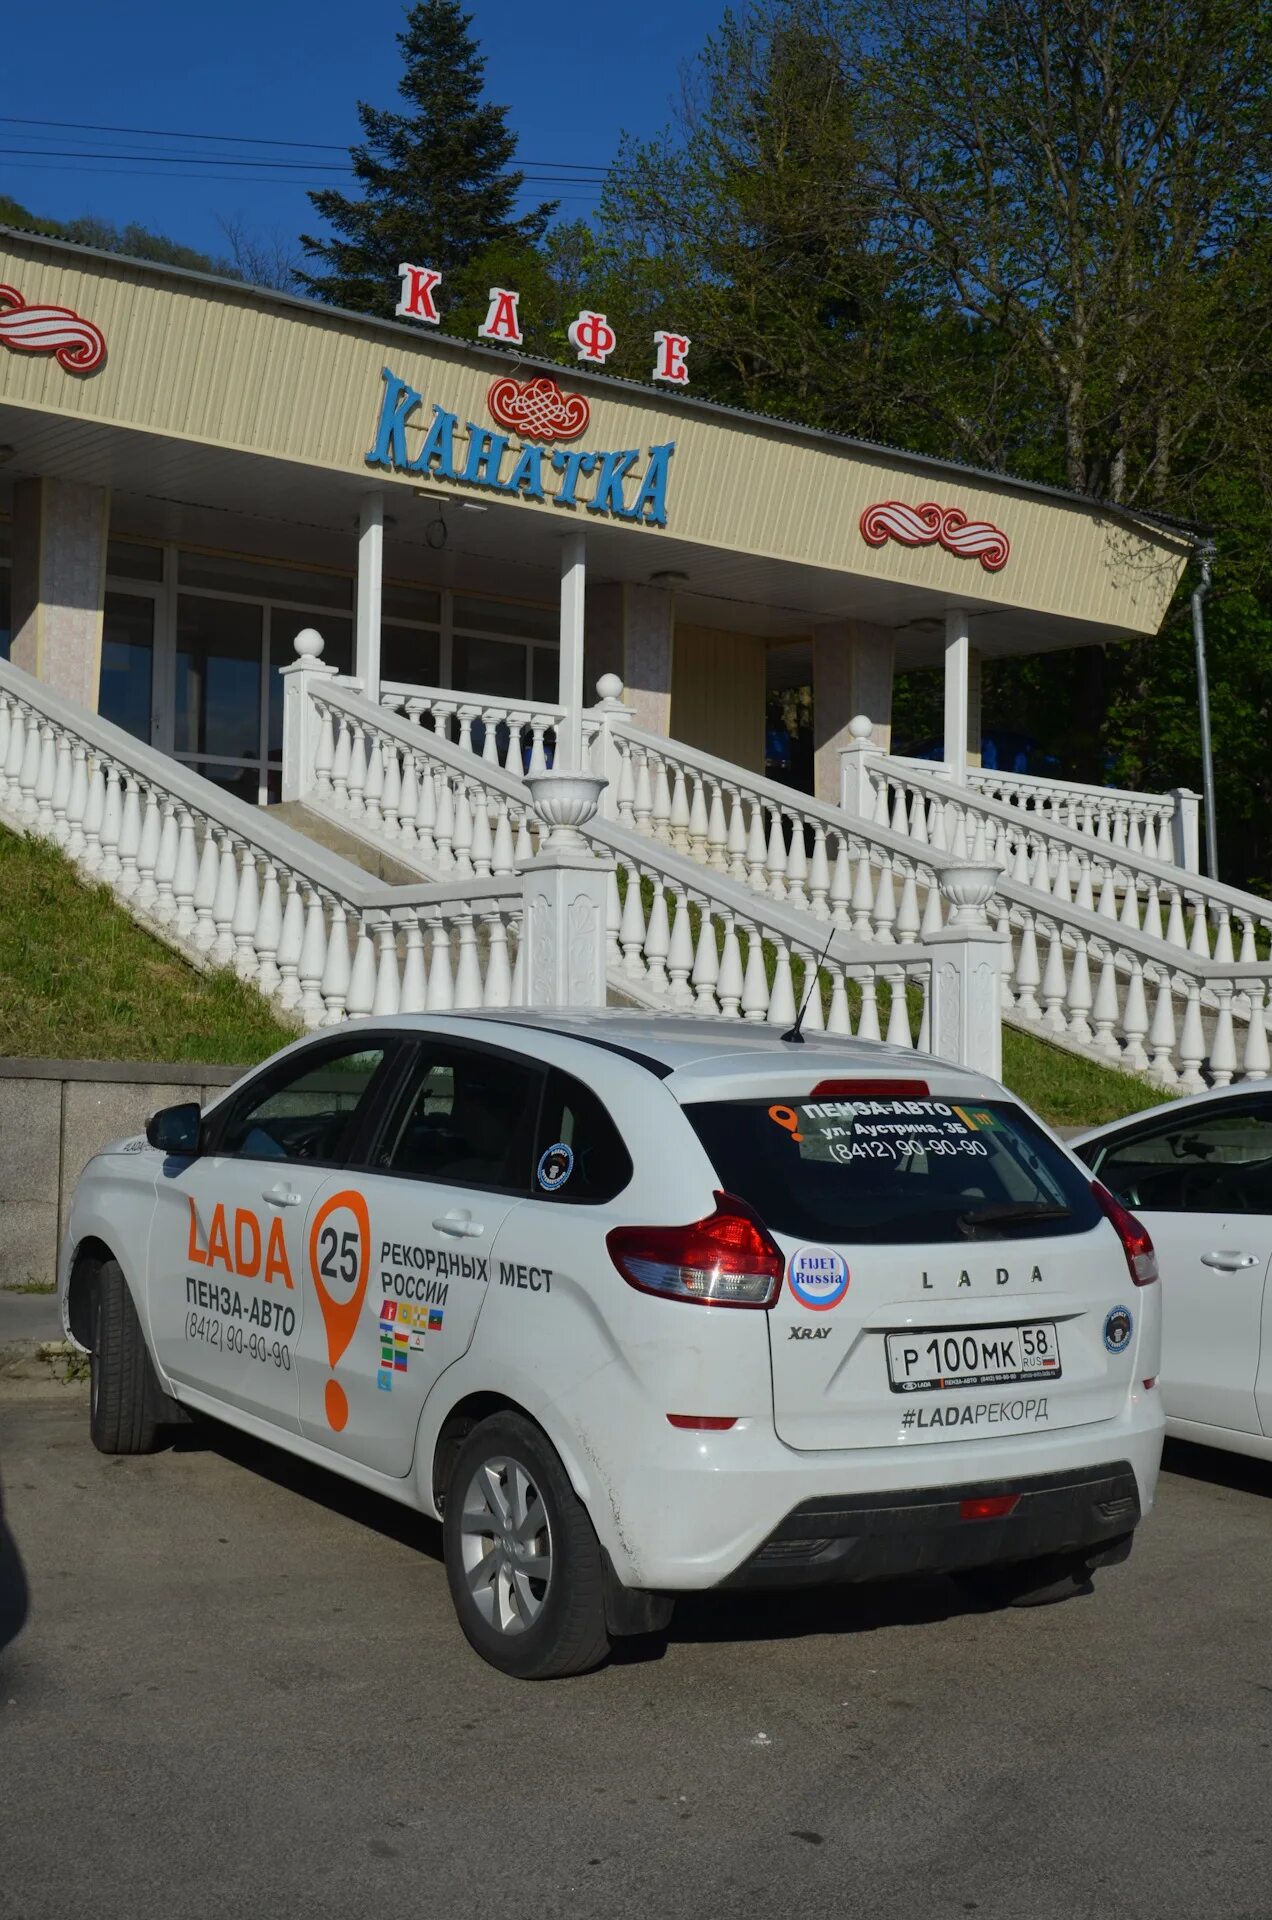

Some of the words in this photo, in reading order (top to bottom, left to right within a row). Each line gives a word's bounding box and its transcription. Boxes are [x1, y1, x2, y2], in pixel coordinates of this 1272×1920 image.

[396, 263, 690, 385] КАФЕ
[364, 366, 675, 526] КАНАТКА
[801, 1101, 952, 1119] ПЕНЗА-АВТО
[820, 1126, 851, 1140] ул.
[854, 1122, 944, 1138] Аустрина,
[828, 1140, 897, 1164] (8412)
[896, 1139, 988, 1156] 90-90-90
[187, 1196, 295, 1290] LADA
[319, 1227, 359, 1283] 25
[380, 1241, 489, 1282] РЕКОРДНЫХ
[500, 1262, 553, 1293] МЕСТ
[796, 1272, 843, 1284] Russia
[800, 1257, 836, 1270] FIJET
[922, 1265, 1043, 1289] LADA
[381, 1271, 449, 1306] РОССИИ
[186, 1277, 296, 1337] ПЕНЗА-АВТО
[185, 1311, 224, 1352] (8412)
[226, 1325, 291, 1371] 90-90-90
[1022, 1329, 1048, 1355] 58
[1023, 1356, 1042, 1367] RUS
